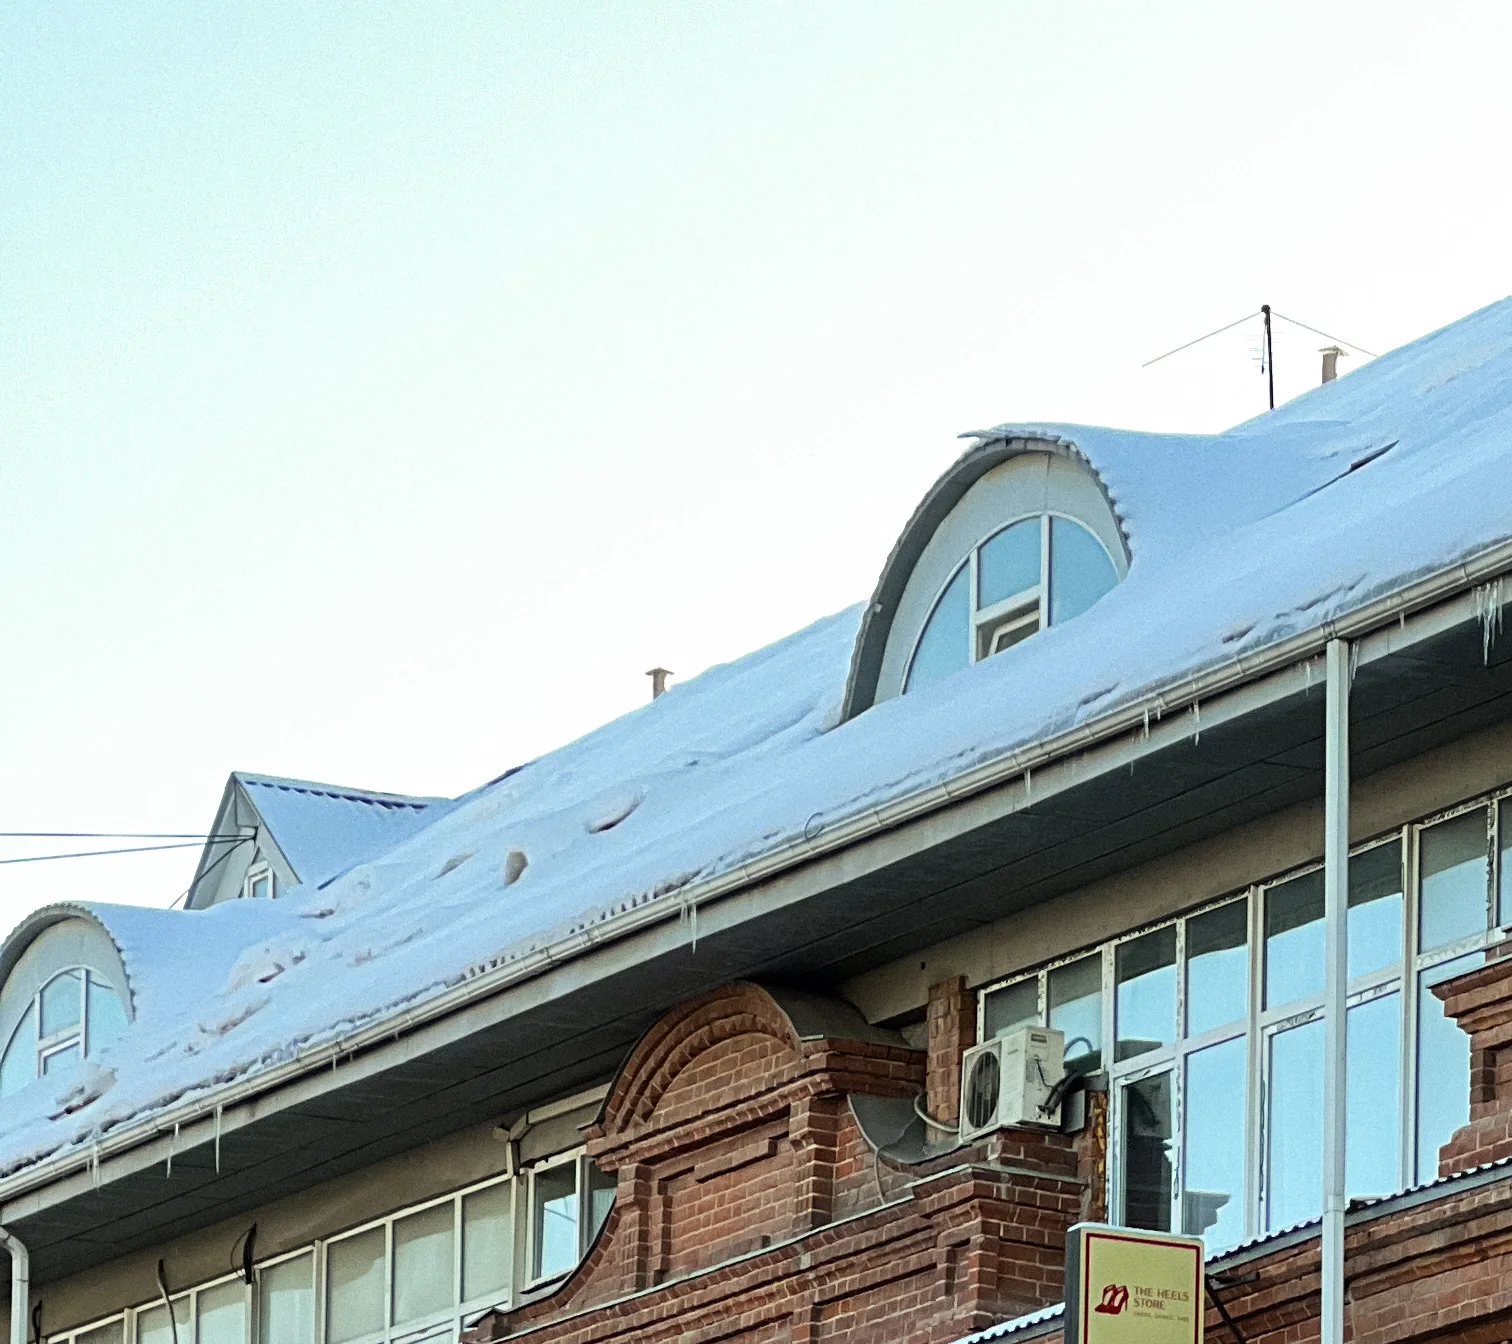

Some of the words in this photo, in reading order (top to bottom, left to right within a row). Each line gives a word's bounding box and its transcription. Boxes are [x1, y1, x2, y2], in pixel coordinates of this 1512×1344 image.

[1134, 1286, 1153, 1297] THE
[1157, 1289, 1189, 1301] HEELS
[1134, 1298, 1165, 1310] STORE
